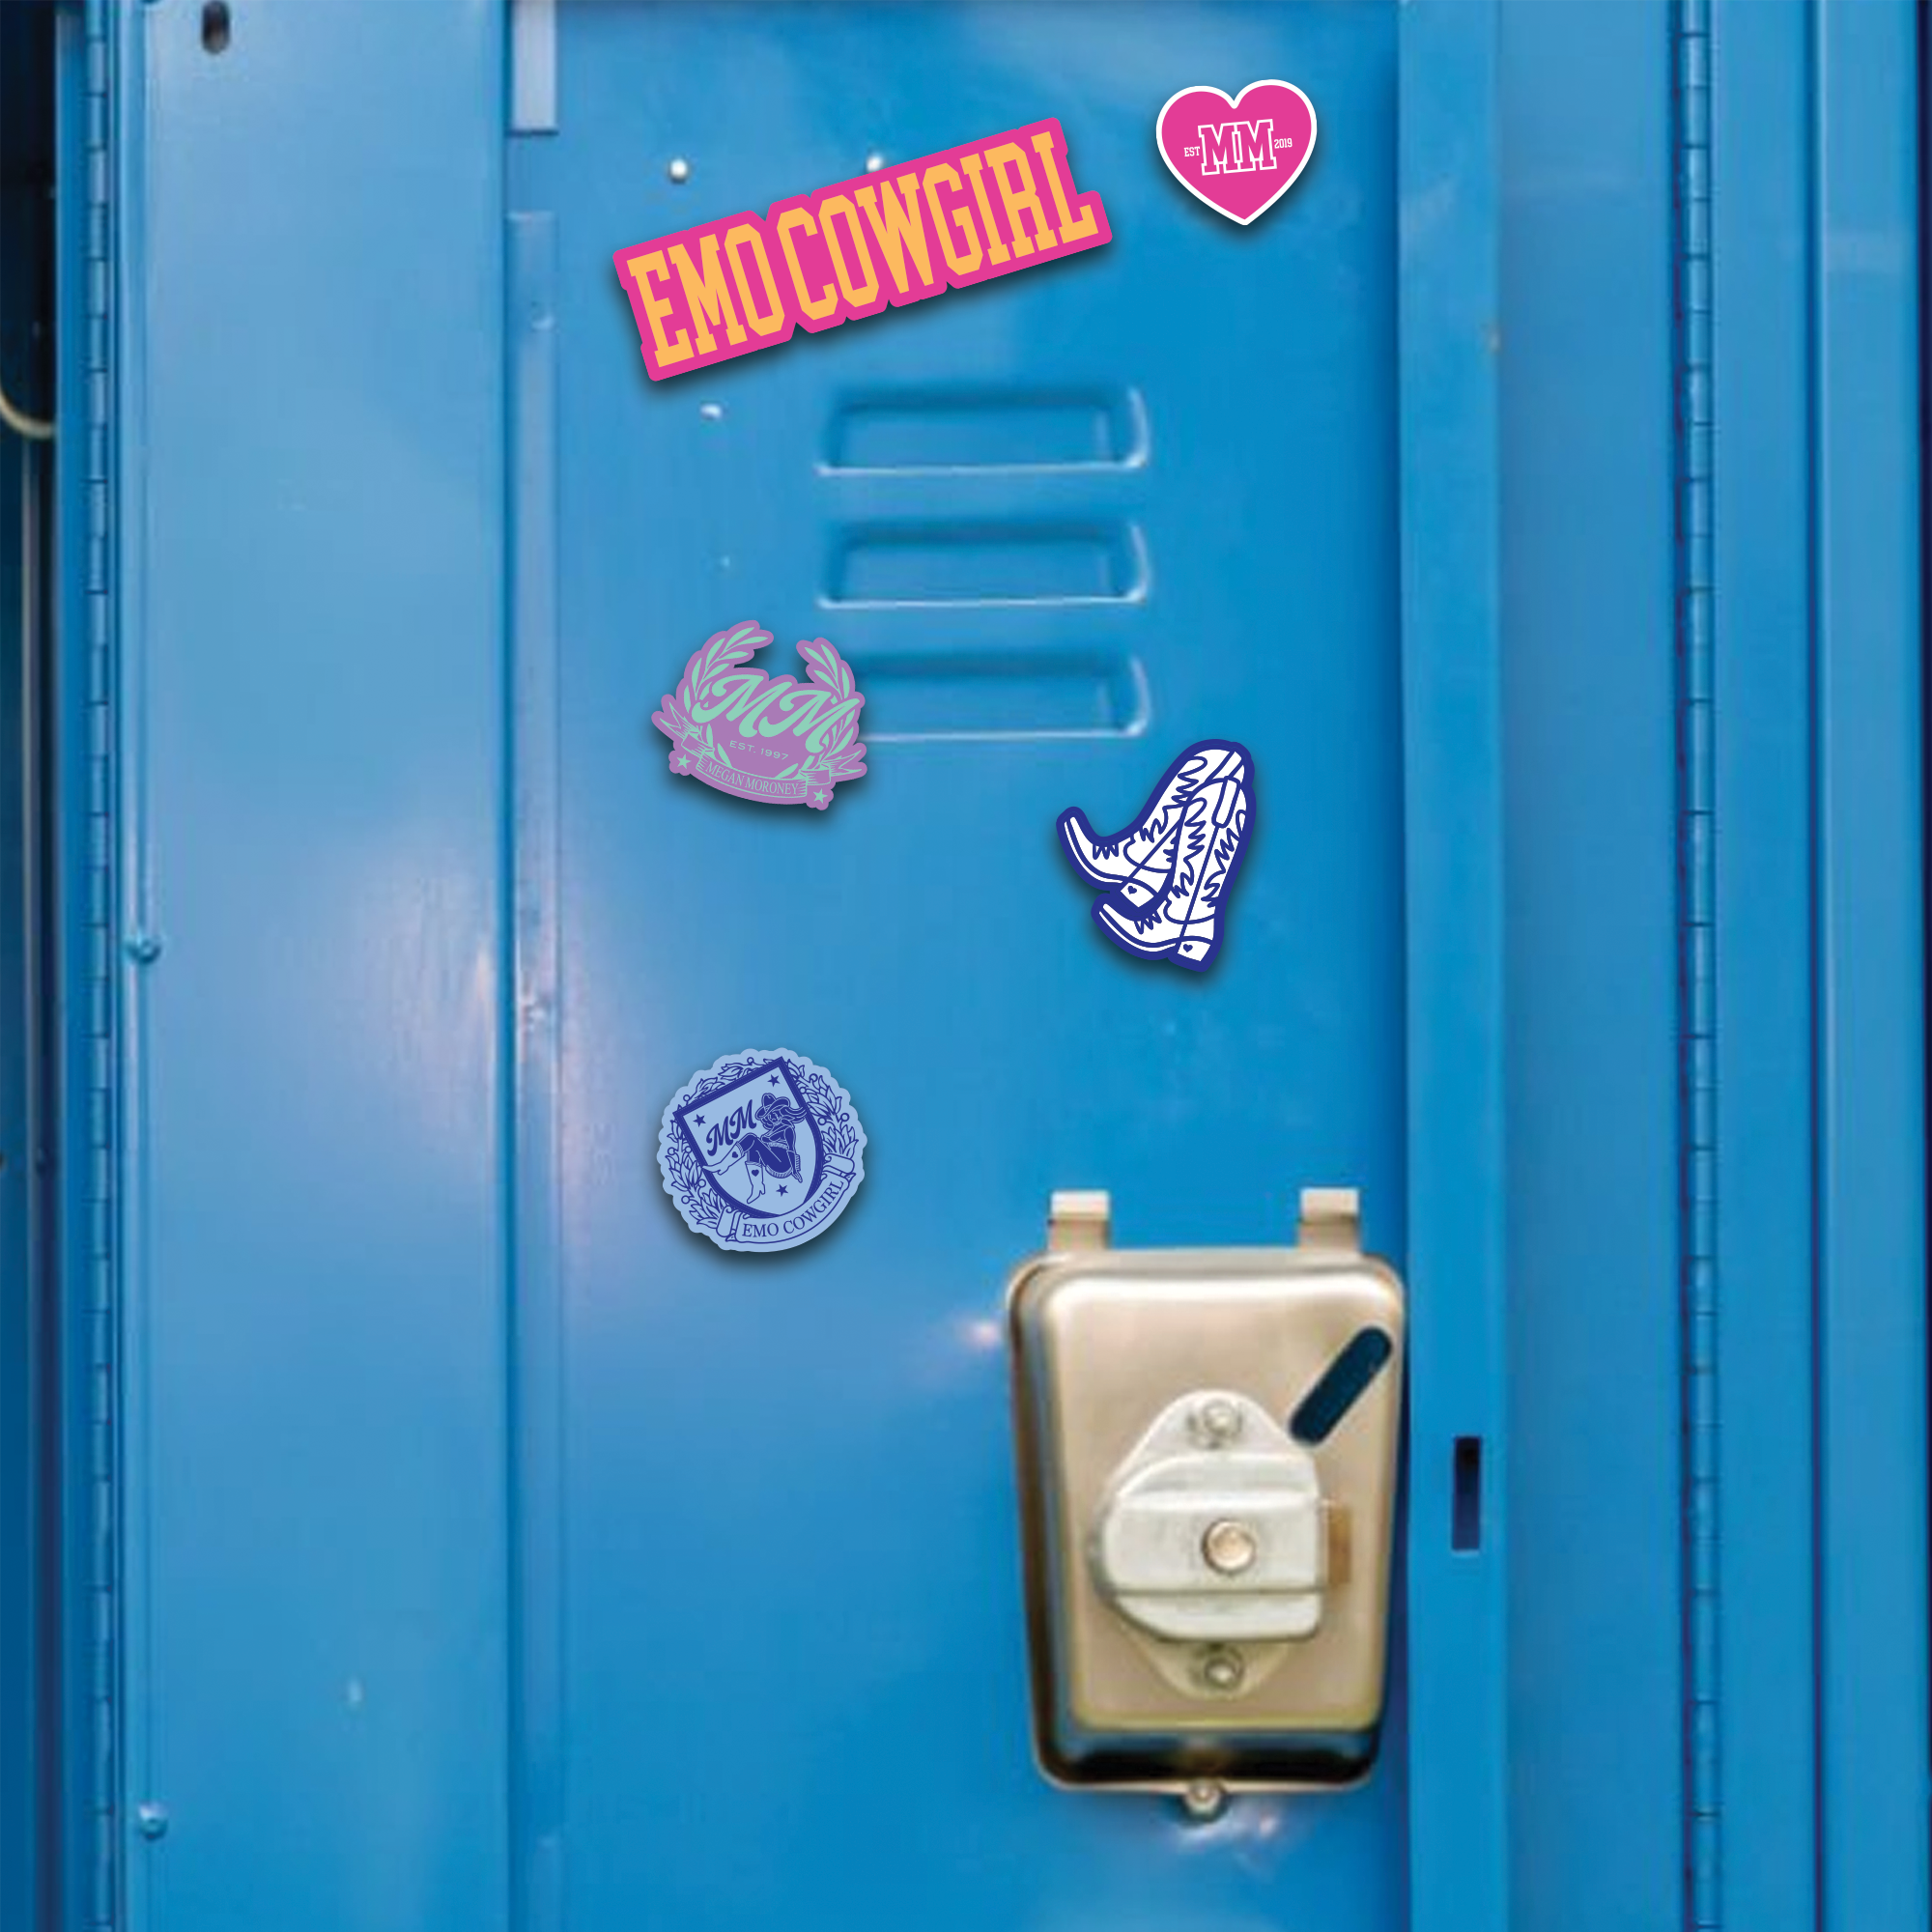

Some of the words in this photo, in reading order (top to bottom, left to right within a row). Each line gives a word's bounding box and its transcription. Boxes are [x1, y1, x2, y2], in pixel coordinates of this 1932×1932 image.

[1183, 146, 1200, 156] EST
[1197, 119, 1277, 176] MM
[1273, 137, 1293, 149] 2019
[626, 223, 785, 368] EMO
[777, 131, 1099, 321] COWGIRL
[691, 674, 861, 753] MM
[705, 761, 745, 786] MEGAN
[744, 777, 799, 795] MORONEY
[729, 740, 756, 753] EST.
[759, 748, 789, 760] 1997
[705, 1099, 757, 1157] MM
[742, 1223, 780, 1237] EMO
[782, 1179, 844, 1235] COWGIRL
